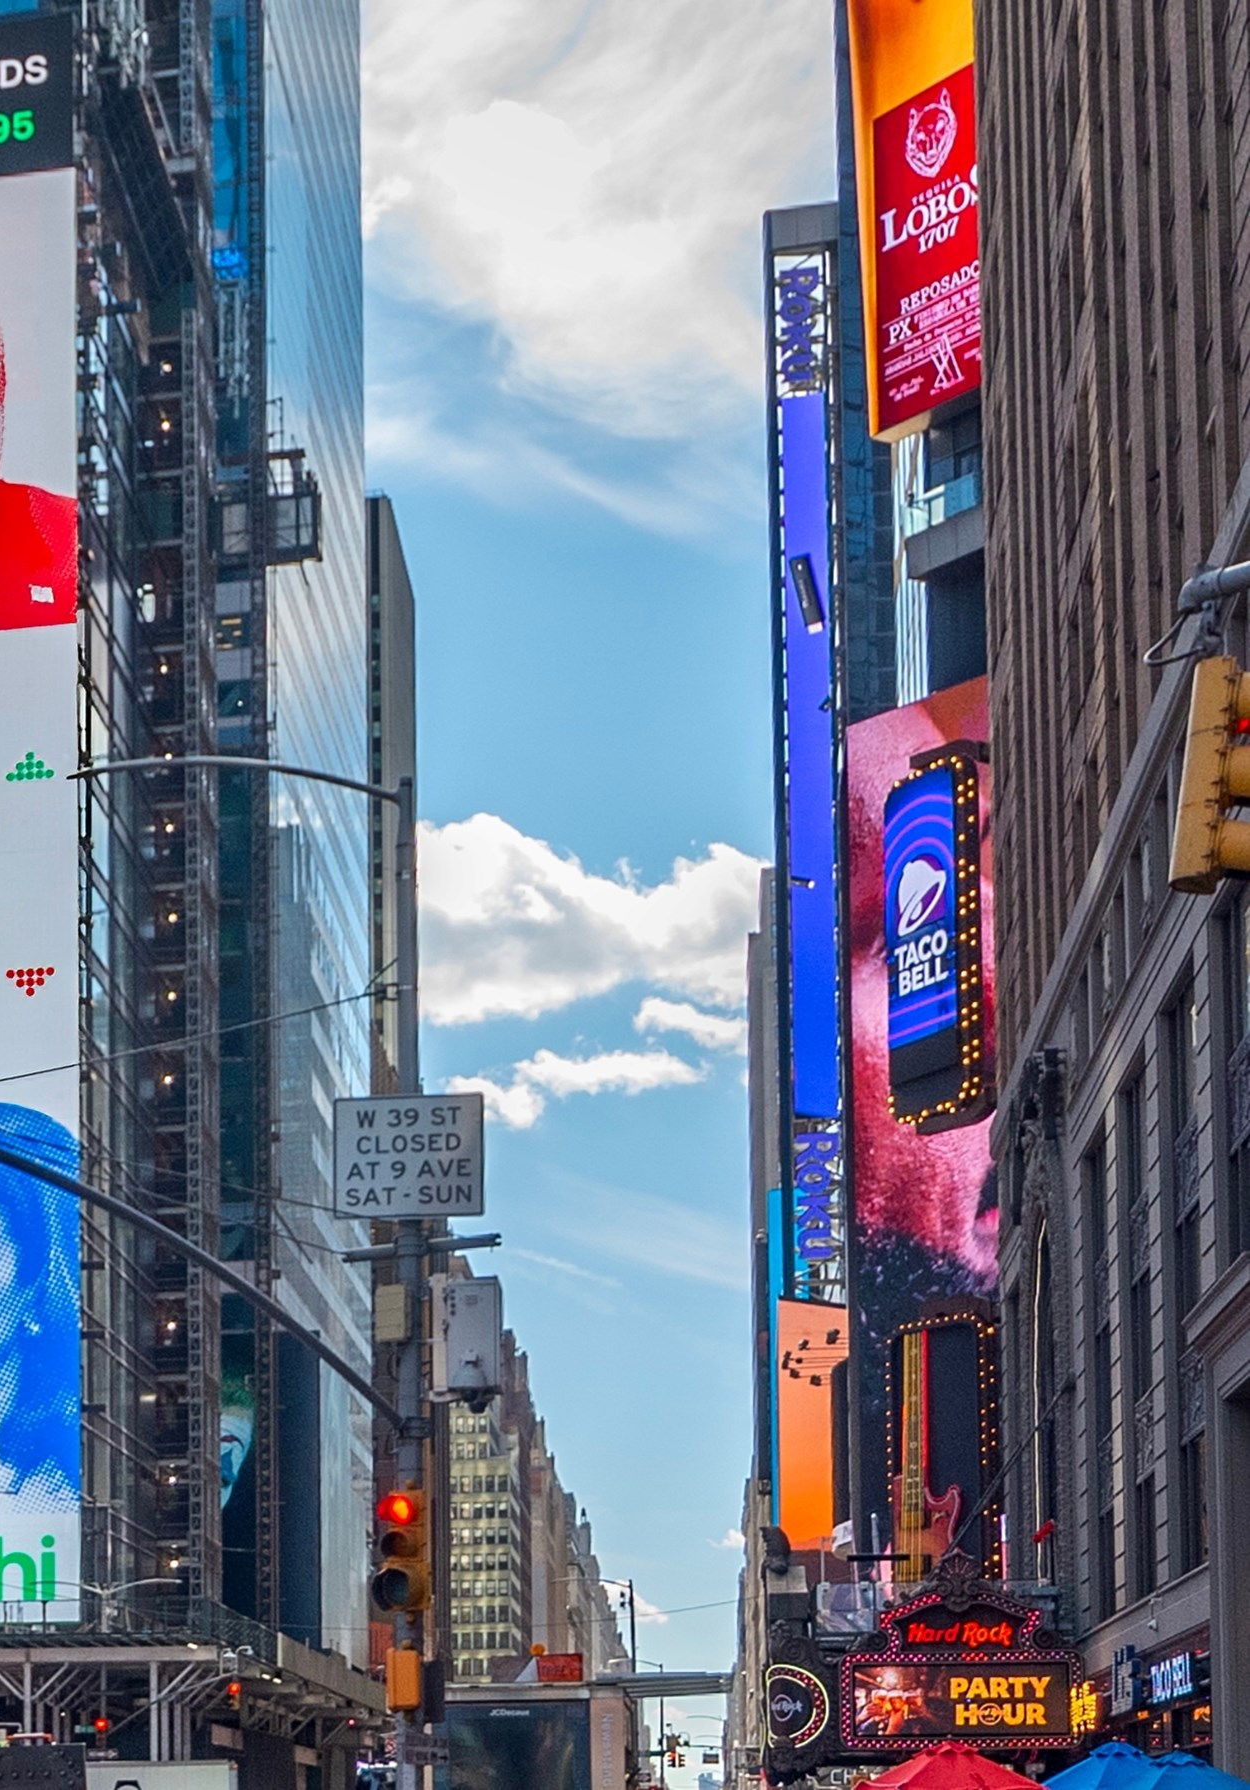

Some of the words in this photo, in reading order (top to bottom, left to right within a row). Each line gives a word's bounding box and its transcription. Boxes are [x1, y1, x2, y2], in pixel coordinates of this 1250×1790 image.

[918, 215, 959, 254] 1707
[889, 316, 912, 345] PX
[894, 929, 948, 971] TACO
[898, 957, 949, 997] BELL
[356, 1110, 376, 1128] W
[387, 1108, 419, 1127] 39
[430, 1106, 461, 1125] ST
[356, 1133, 461, 1154] CLOSED
[347, 1162, 381, 1180] AT
[391, 1160, 406, 1179] 9
[417, 1158, 472, 1178] AVE
[907, 1622, 961, 1643] Hard
[961, 1621, 1013, 1648] Rock
[950, 1676, 1051, 1699] PARTY
[955, 1702, 1047, 1726] HOUR
